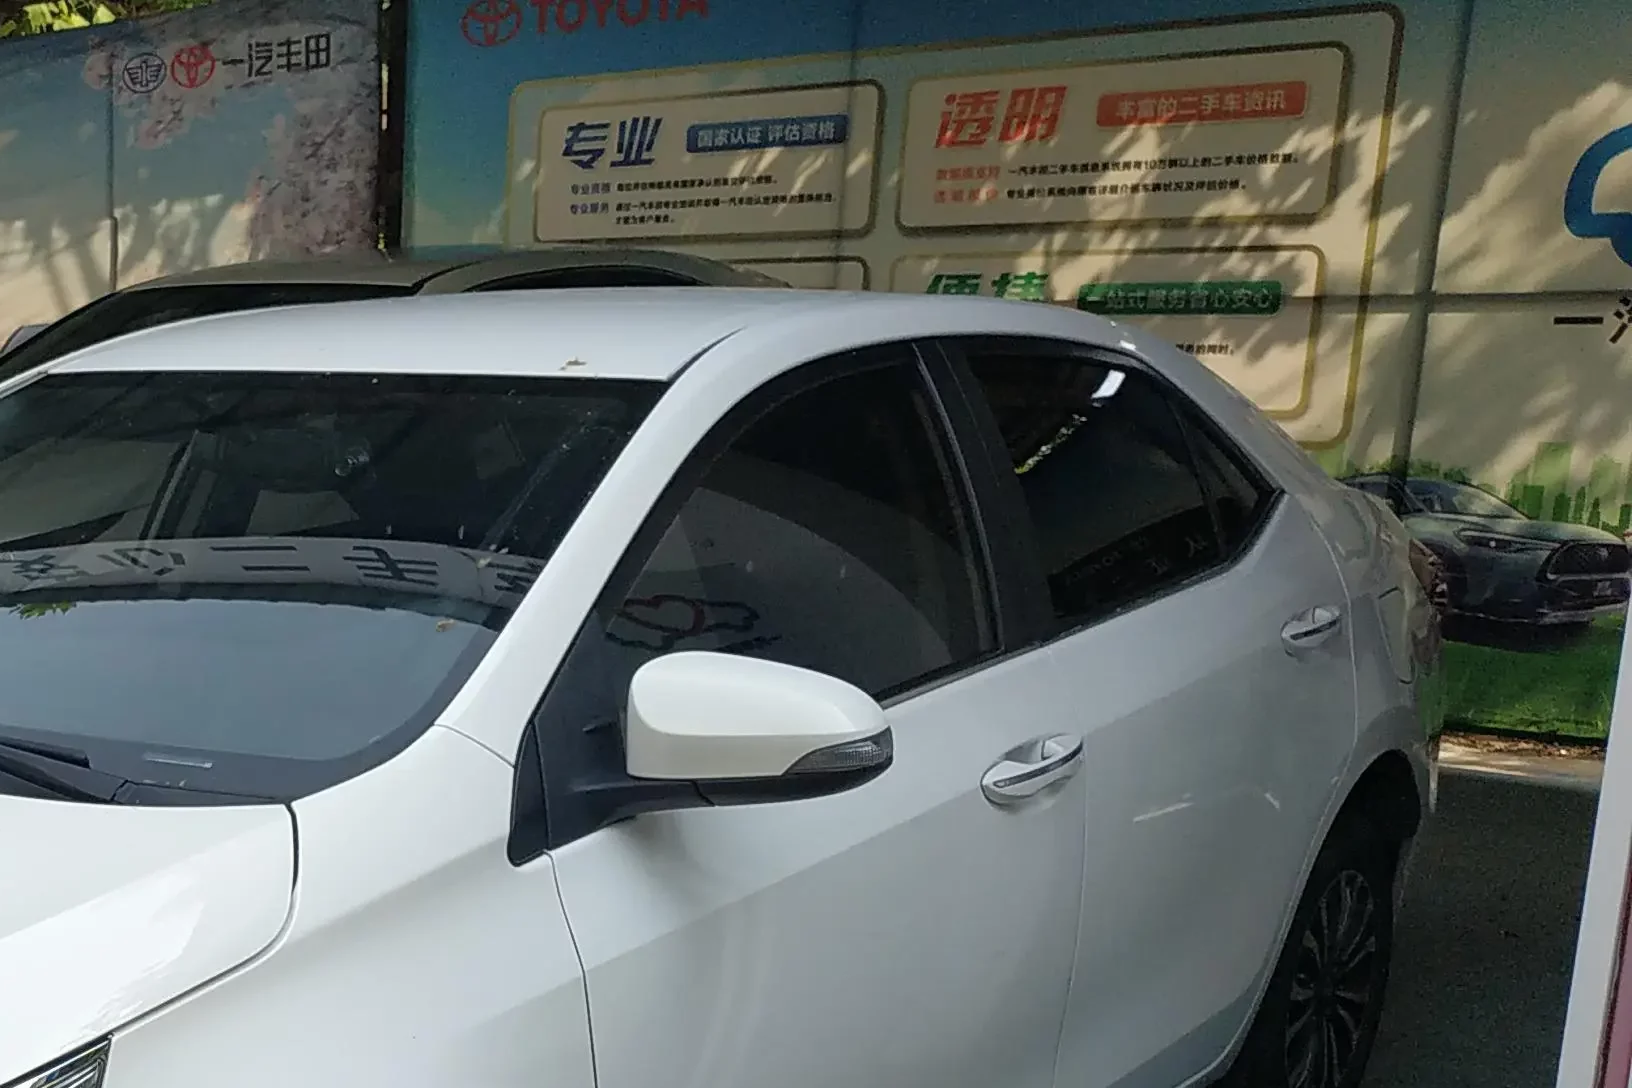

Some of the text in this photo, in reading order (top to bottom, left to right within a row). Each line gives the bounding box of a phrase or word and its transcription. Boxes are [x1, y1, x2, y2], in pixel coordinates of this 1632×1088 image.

[222, 34, 332, 78] 一汽丰田
[562, 115, 663, 170] 专业
[696, 127, 763, 149] 国家认证
[934, 85, 1286, 148] 透明 丰富的二手车资讯
